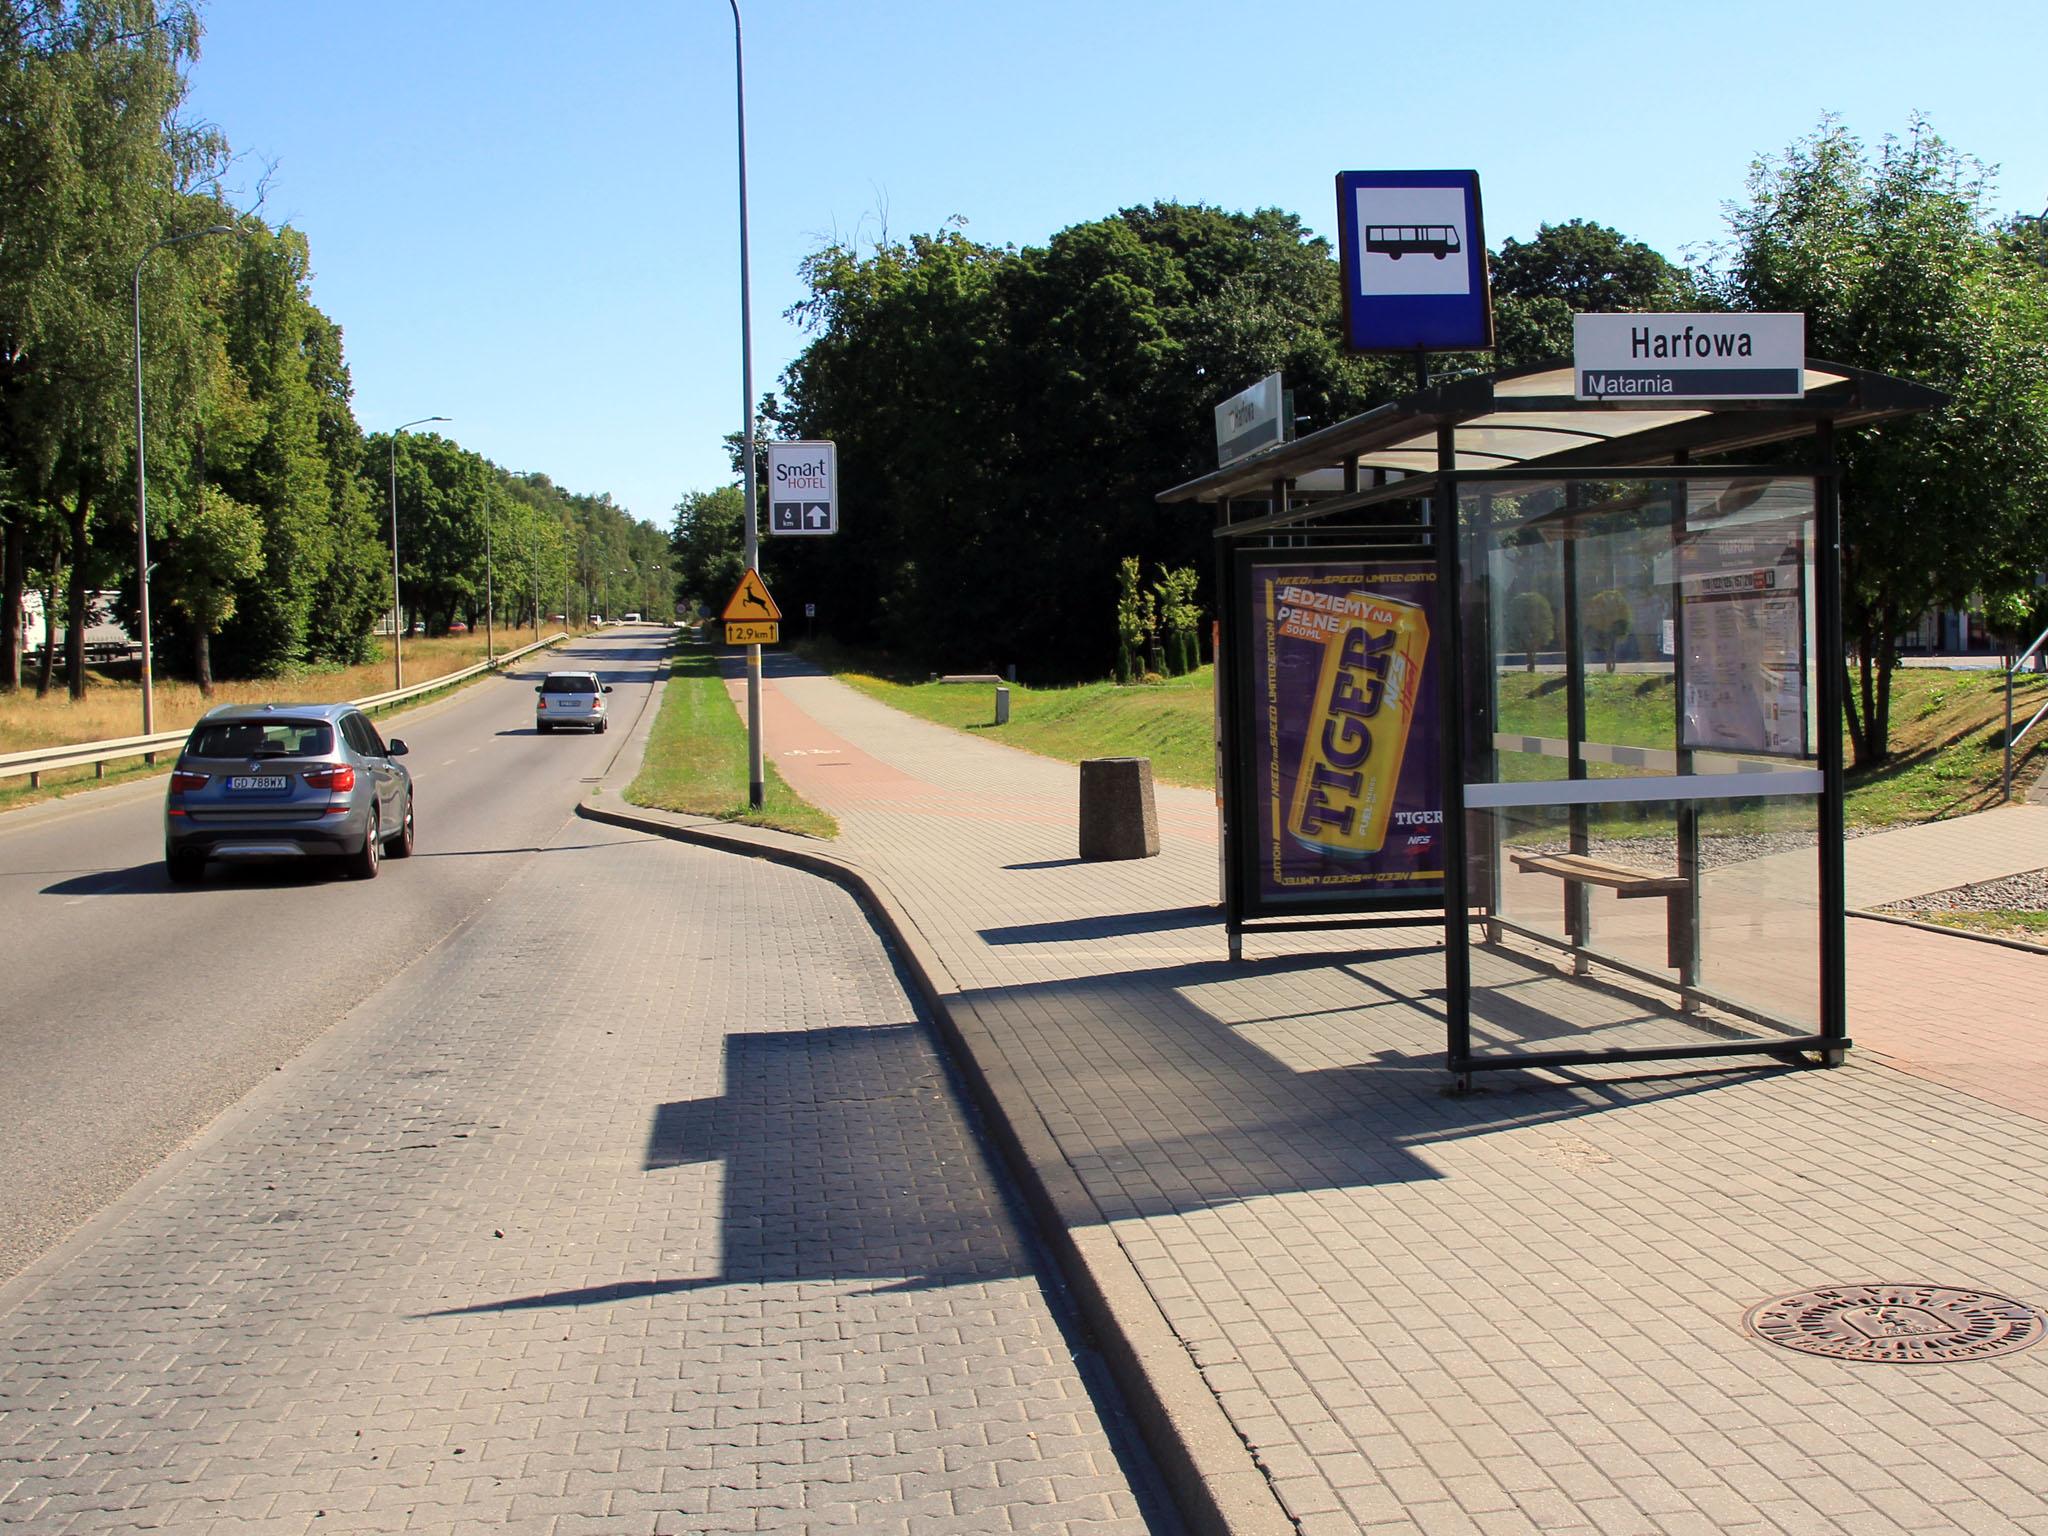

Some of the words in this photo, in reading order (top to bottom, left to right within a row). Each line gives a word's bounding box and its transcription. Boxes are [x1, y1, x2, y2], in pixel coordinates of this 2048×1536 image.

[1631, 326, 1752, 358] Harfowa
[1588, 374, 1673, 393] Matarnia
[776, 459, 826, 481] Smart
[788, 478, 826, 489] HOTEL
[784, 508, 792, 519] 6
[1277, 586, 1374, 618] JEDZIEMY
[1373, 610, 1393, 623] NA
[1277, 607, 1349, 634] PEŁNEJ
[736, 628, 754, 641] 2,9
[754, 630, 768, 639] km
[1287, 624, 1320, 639] 500ML
[1301, 626, 1398, 836] TIGER
[234, 778, 248, 788] GD
[251, 777, 283, 788] 788WX
[1395, 811, 1443, 825] TIGER
[1407, 836, 1431, 845] NFS
